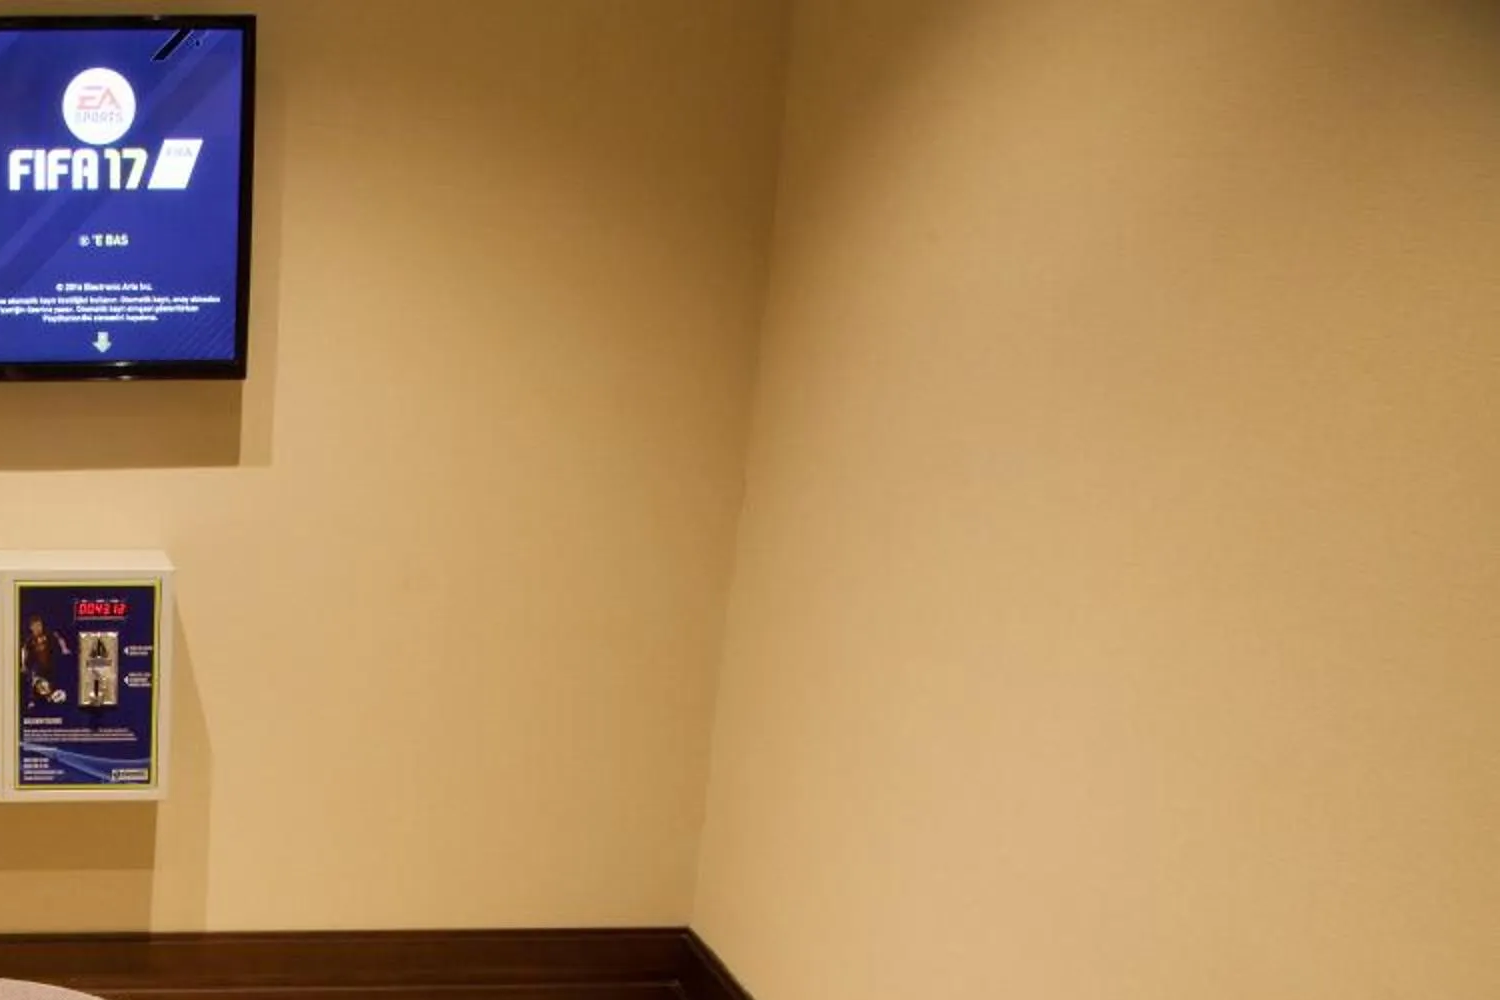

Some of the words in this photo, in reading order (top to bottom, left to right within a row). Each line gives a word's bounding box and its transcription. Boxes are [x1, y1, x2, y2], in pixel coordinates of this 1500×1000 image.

[77, 86, 122, 110] EA
[75, 110, 124, 124] SPORTS
[8, 148, 99, 191] FIFA
[104, 147, 148, 190] 17
